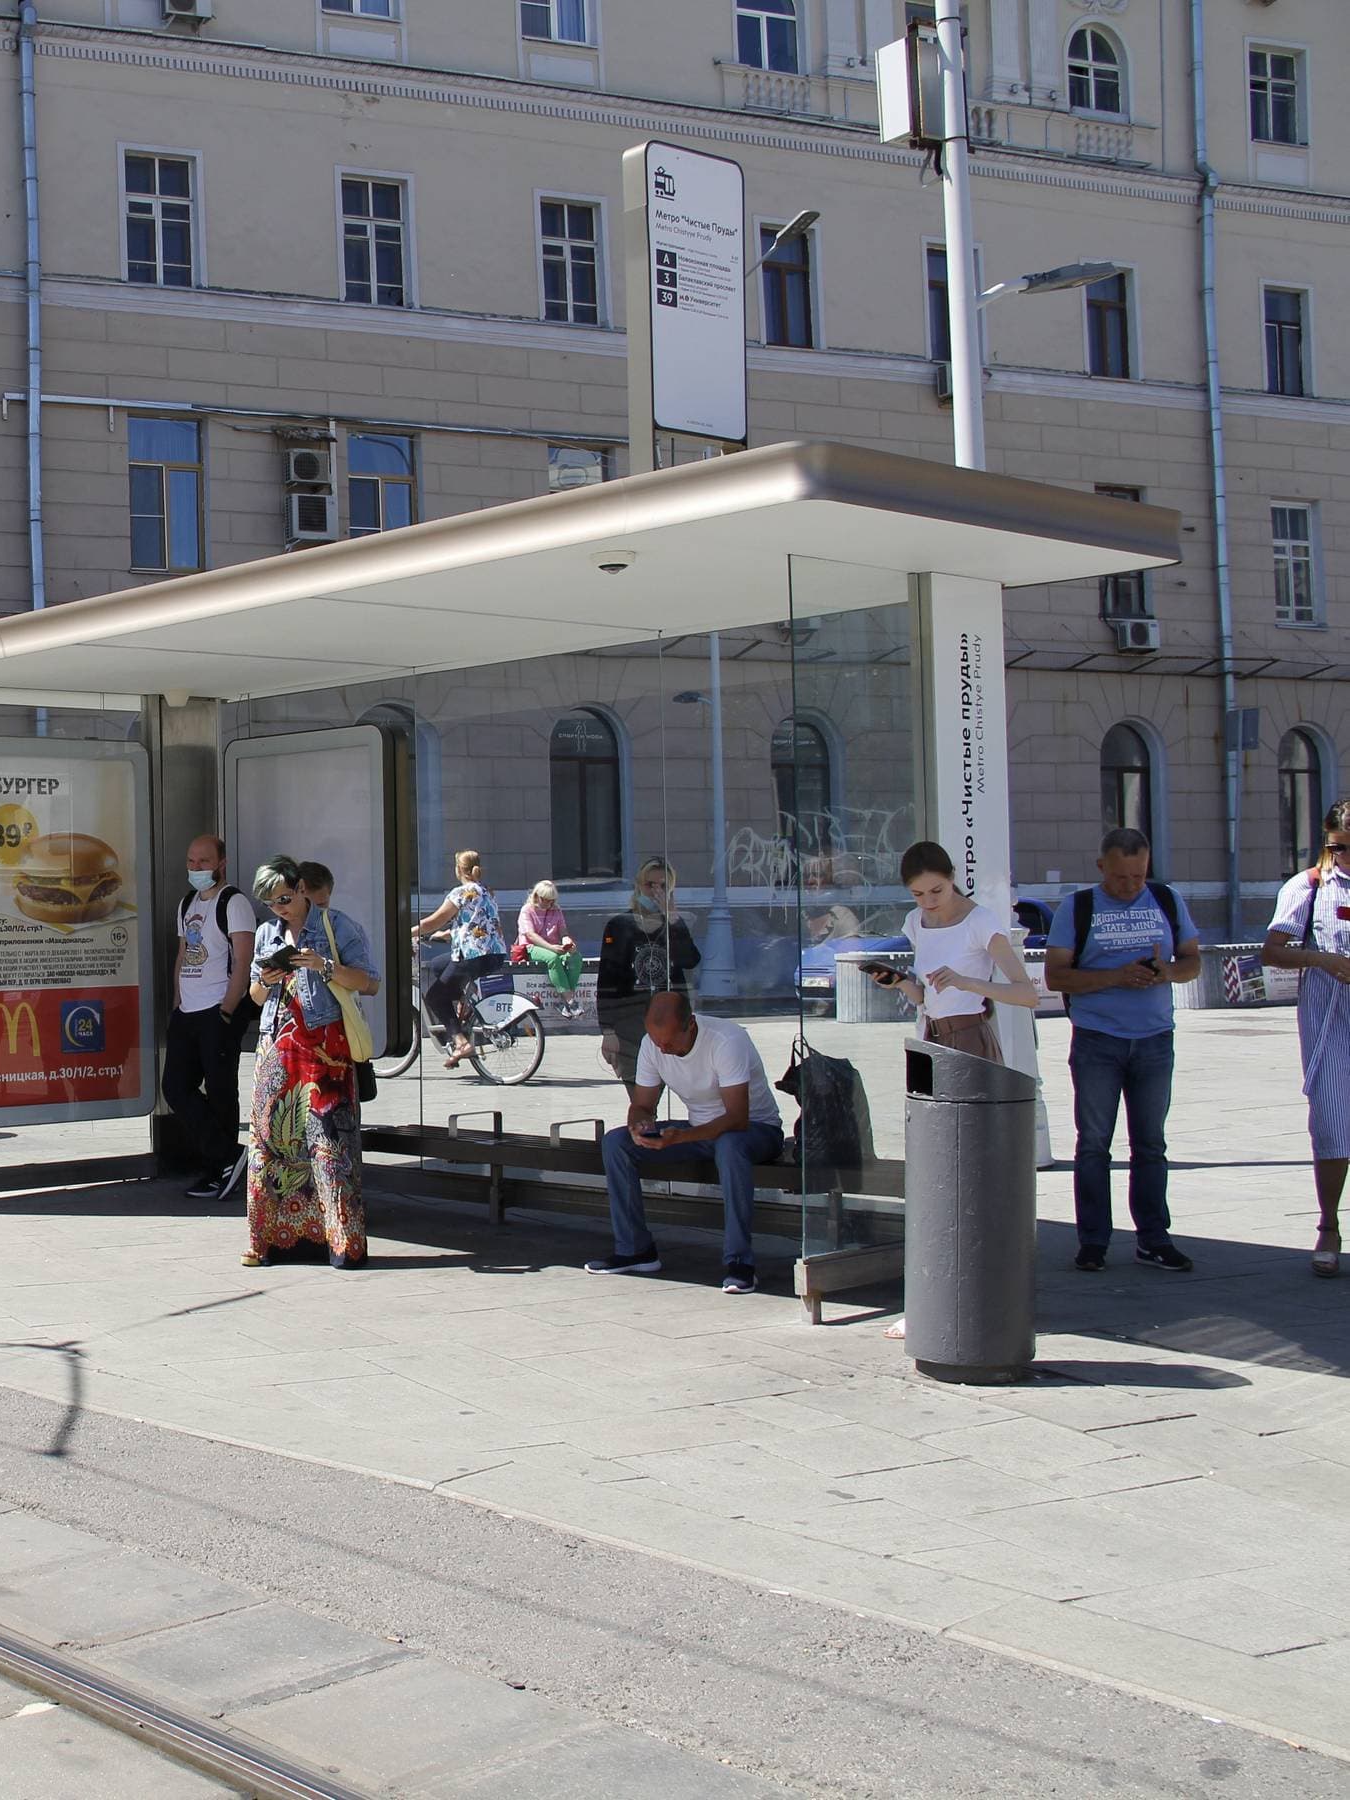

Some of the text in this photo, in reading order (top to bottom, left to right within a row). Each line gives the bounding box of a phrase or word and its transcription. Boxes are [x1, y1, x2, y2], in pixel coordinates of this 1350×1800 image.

[655, 209, 680, 223] Метро
[663, 272, 670, 284] 3
[661, 291, 673, 304] 39
[972, 634, 986, 794] Metro Chistye Prudy
[959, 633, 976, 898] етро «Чистые пруды»
[27, 924, 43, 933] стр.1
[1101, 921, 1156, 933] STATE MIND
[0, 938, 43, 946] приложении
[112, 932, 126, 941] 16+
[1113, 937, 1150, 945] FREEDOM
[496, 1002, 514, 1013] ВТБ
[78, 1018, 93, 1032] 24
[49, 1065, 97, 1081] д.30/1/2,
[98, 1064, 124, 1079] стр.1
